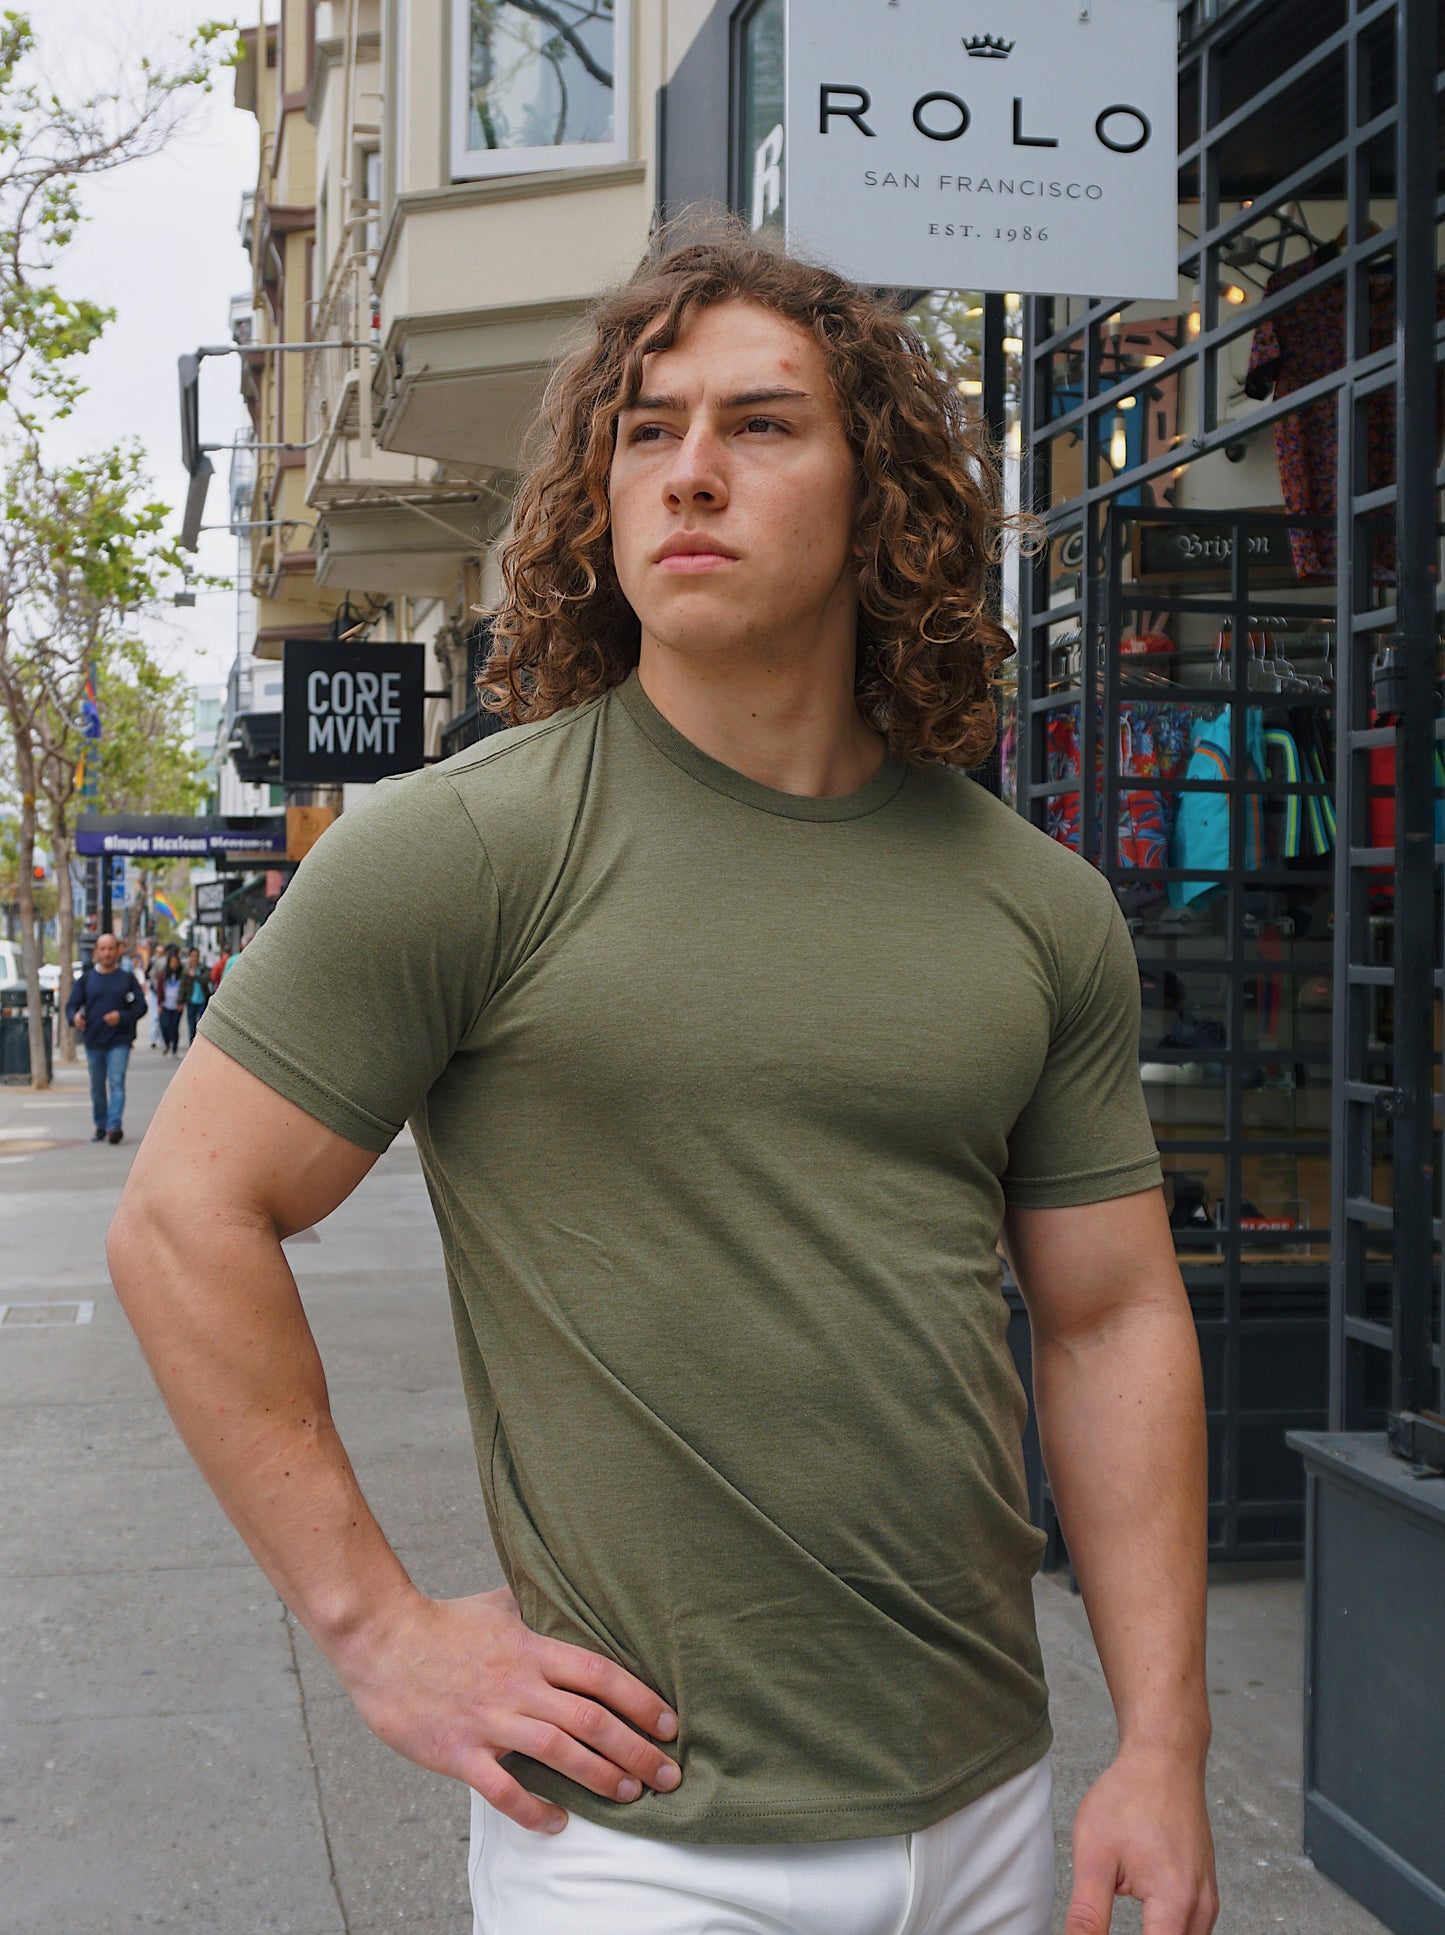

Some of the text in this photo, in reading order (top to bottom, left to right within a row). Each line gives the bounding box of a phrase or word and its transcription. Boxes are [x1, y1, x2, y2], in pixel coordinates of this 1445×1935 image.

[819, 82, 1152, 153] ROLO
[864, 170, 1103, 200] SAN FRANCISCO
[928, 223, 1049, 243] EST. 1986
[307, 670, 402, 716] CORE
[308, 715, 402, 754] MVMT
[104, 834, 150, 854] Simple
[152, 835, 208, 851] Mexican
